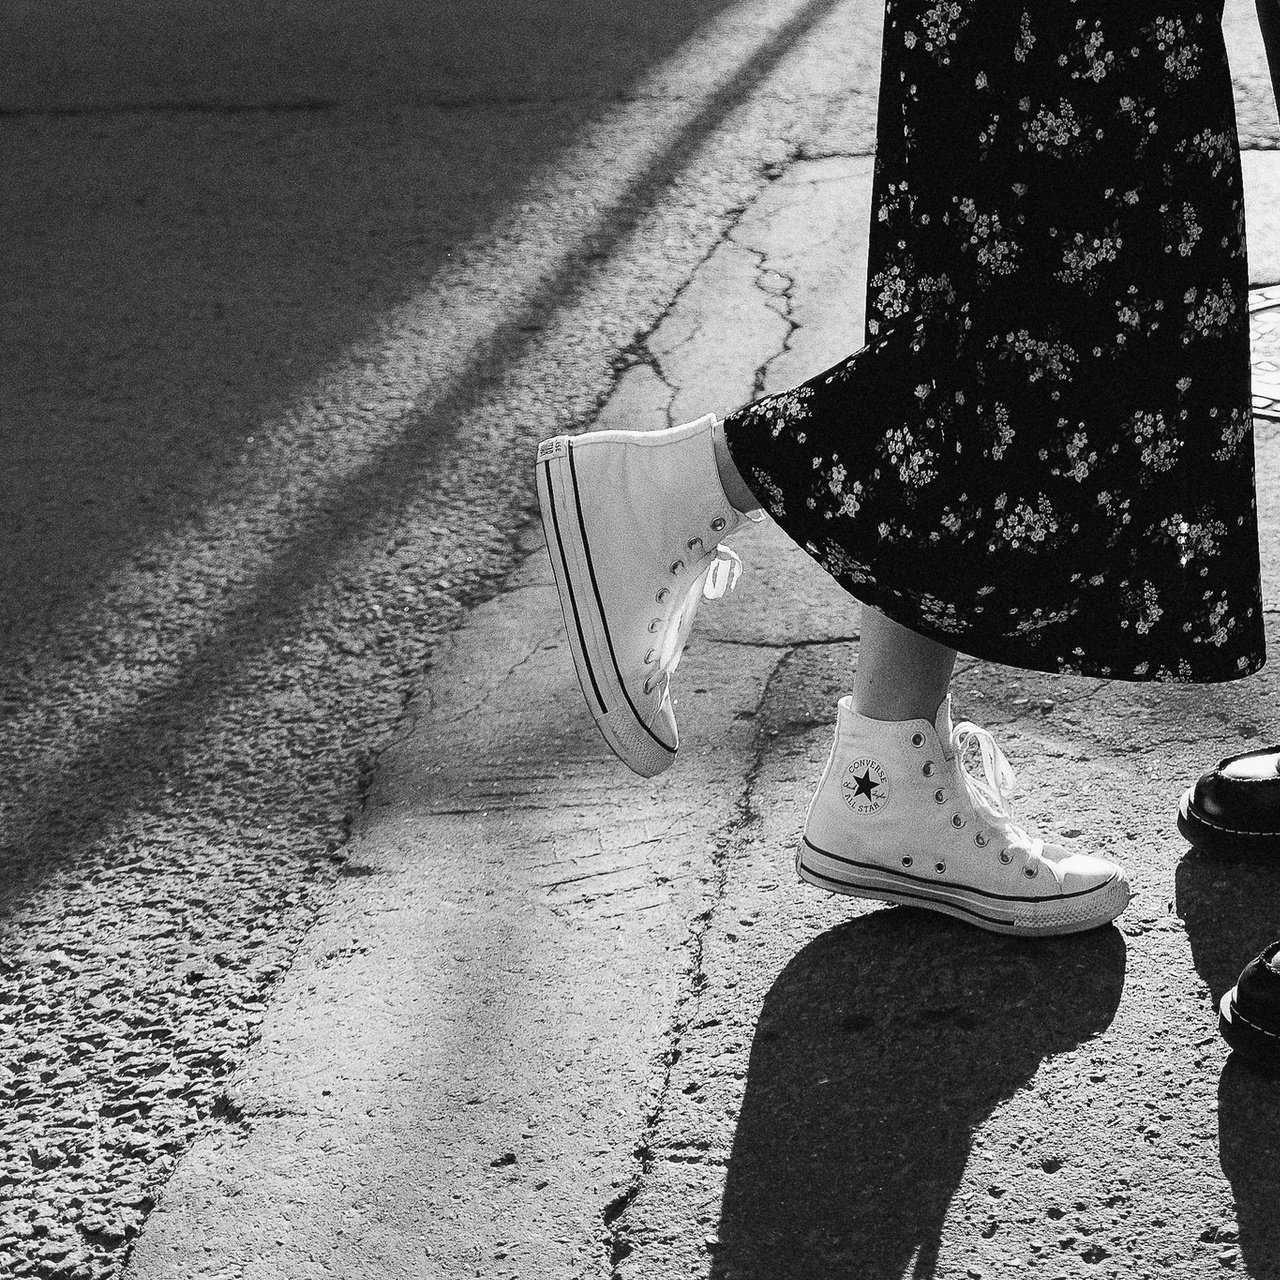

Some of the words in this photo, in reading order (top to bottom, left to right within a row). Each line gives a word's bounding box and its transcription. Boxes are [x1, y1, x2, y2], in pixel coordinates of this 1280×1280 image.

[848, 759, 887, 783] CONVERSE
[845, 794, 856, 809] ALL
[858, 801, 880, 812] STAR
